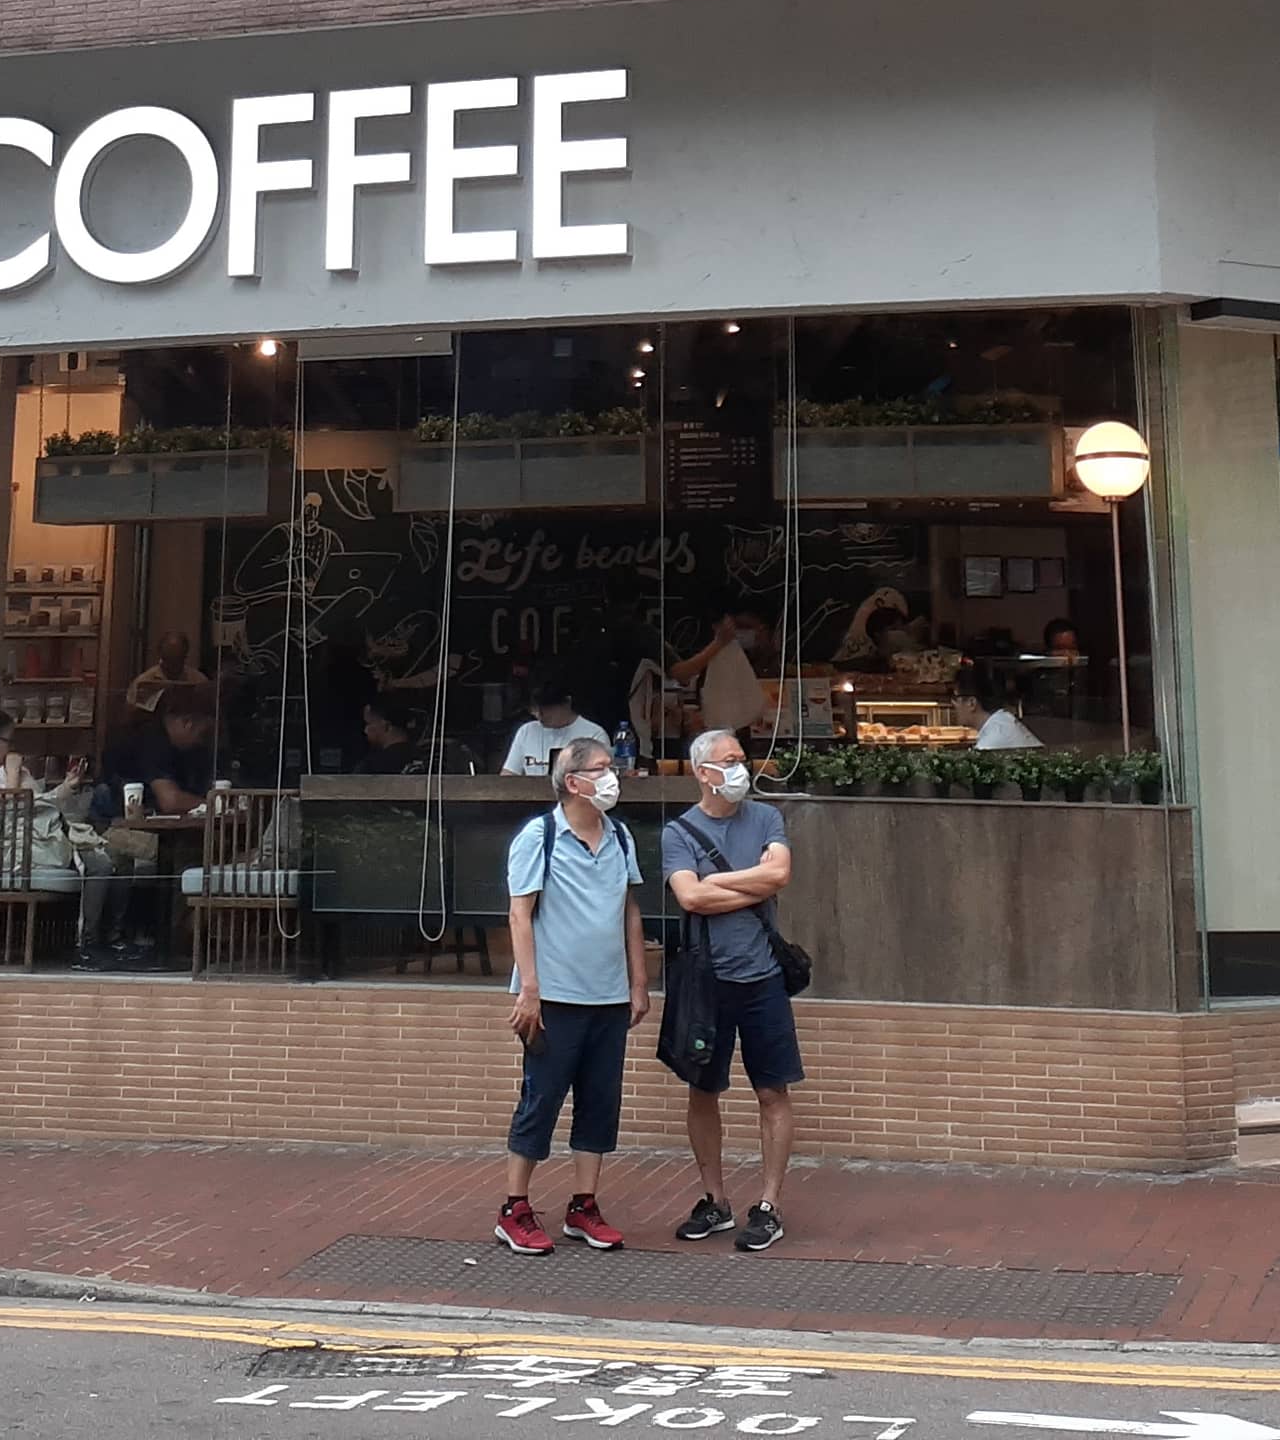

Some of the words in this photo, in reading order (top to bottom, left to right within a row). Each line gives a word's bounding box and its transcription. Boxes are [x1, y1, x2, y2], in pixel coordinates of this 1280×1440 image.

[456, 528, 565, 592] Life
[213, 1384, 558, 1418] LEFT
[552, 1397, 918, 1440] LOOK
